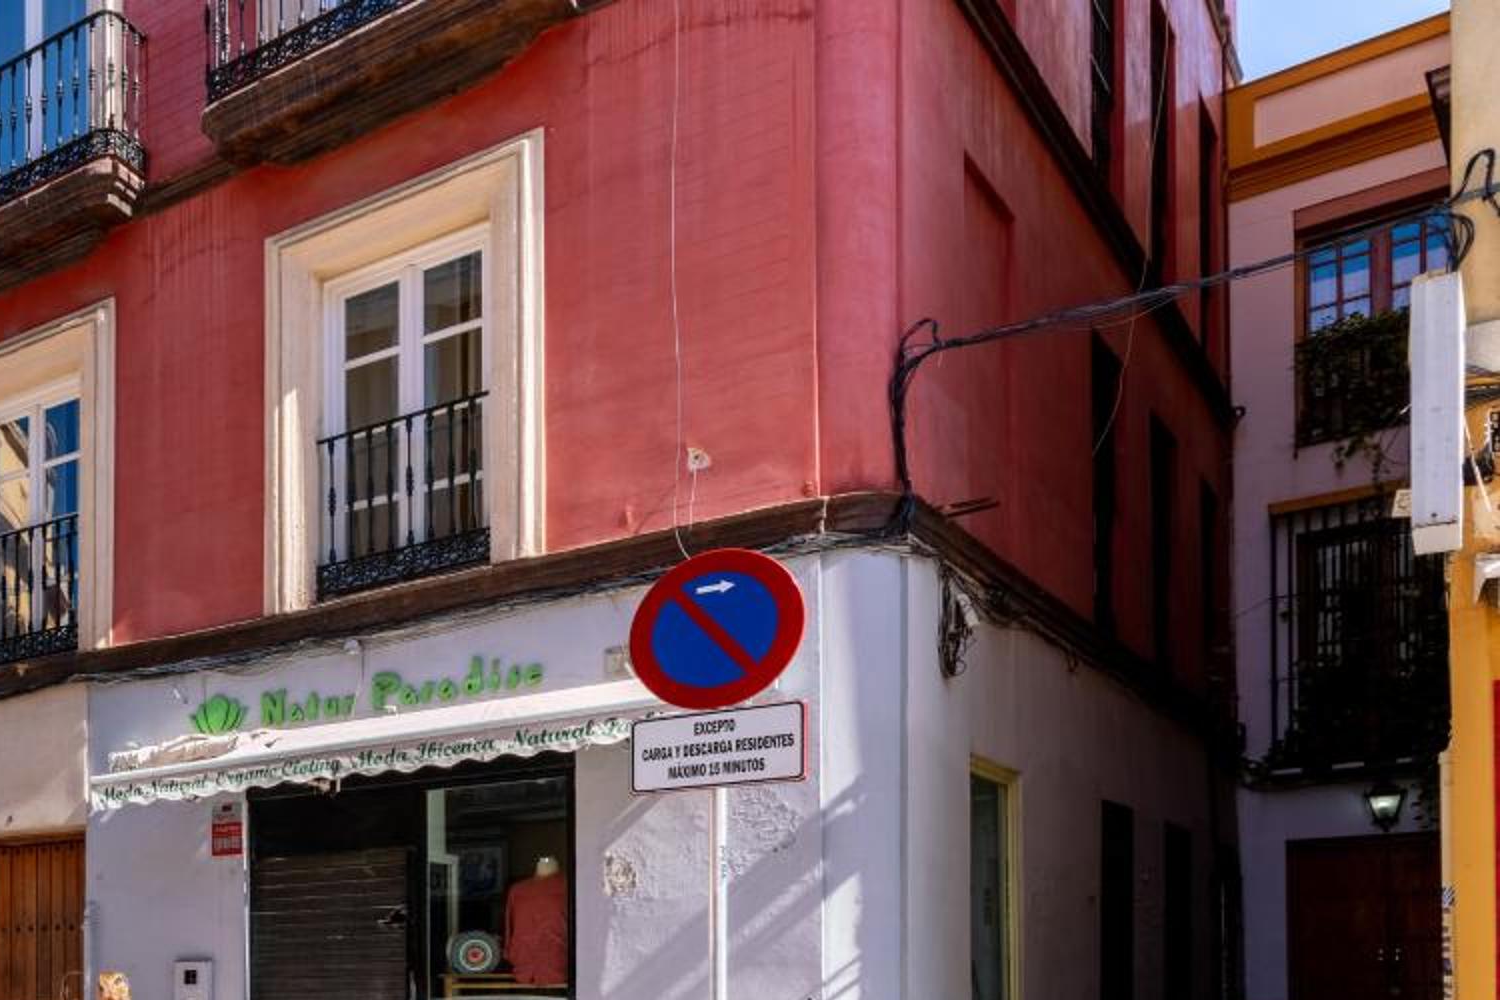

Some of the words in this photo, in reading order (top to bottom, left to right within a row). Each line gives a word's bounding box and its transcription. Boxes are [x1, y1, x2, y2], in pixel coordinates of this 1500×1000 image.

[260, 688, 356, 726] Natur
[370, 656, 544, 711] Paradise
[693, 719, 736, 736] EXCEPTO
[354, 748, 408, 768] Moda
[642, 746, 673, 761] CARGA
[674, 745, 681, 758] Y
[683, 740, 733, 757] DESCARGA
[735, 733, 795, 752] RESIDENTES
[668, 761, 707, 780] MÁXIMO
[709, 762, 721, 776] 15
[722, 757, 766, 774] MINUTOS
